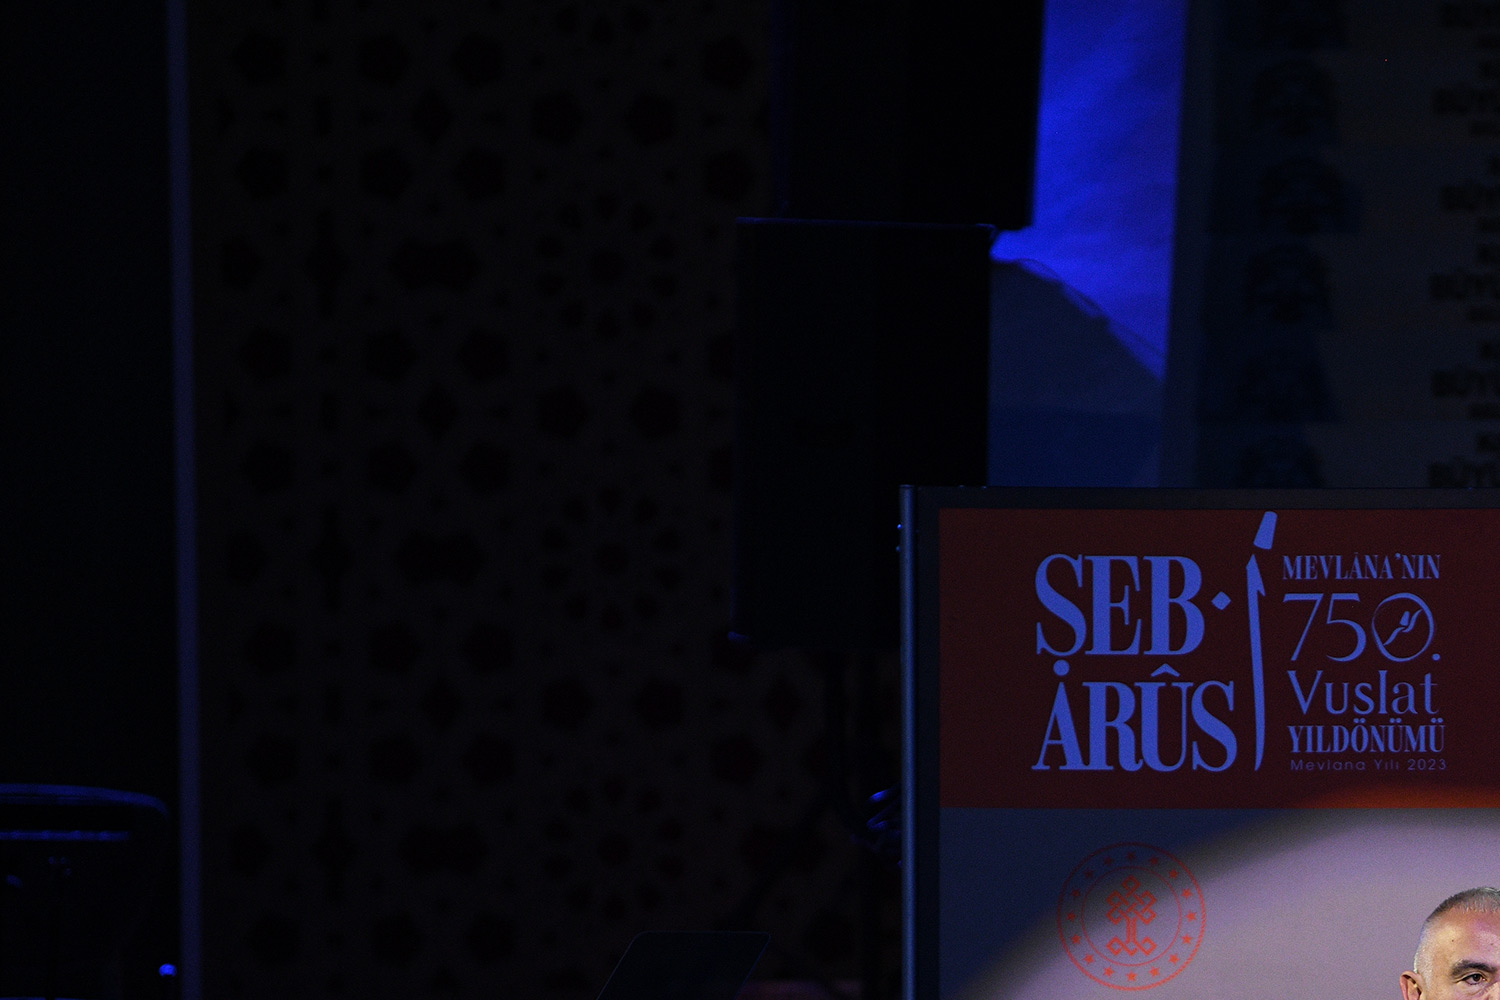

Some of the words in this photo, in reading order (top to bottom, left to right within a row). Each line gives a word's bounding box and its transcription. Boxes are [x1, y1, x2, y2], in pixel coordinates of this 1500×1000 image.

[1287, 669, 1440, 716] Vuslat
[1287, 717, 1446, 754] YILDÖNÜMÜ
[1290, 759, 1366, 771] Mevlana
[1408, 758, 1447, 771] 2023
